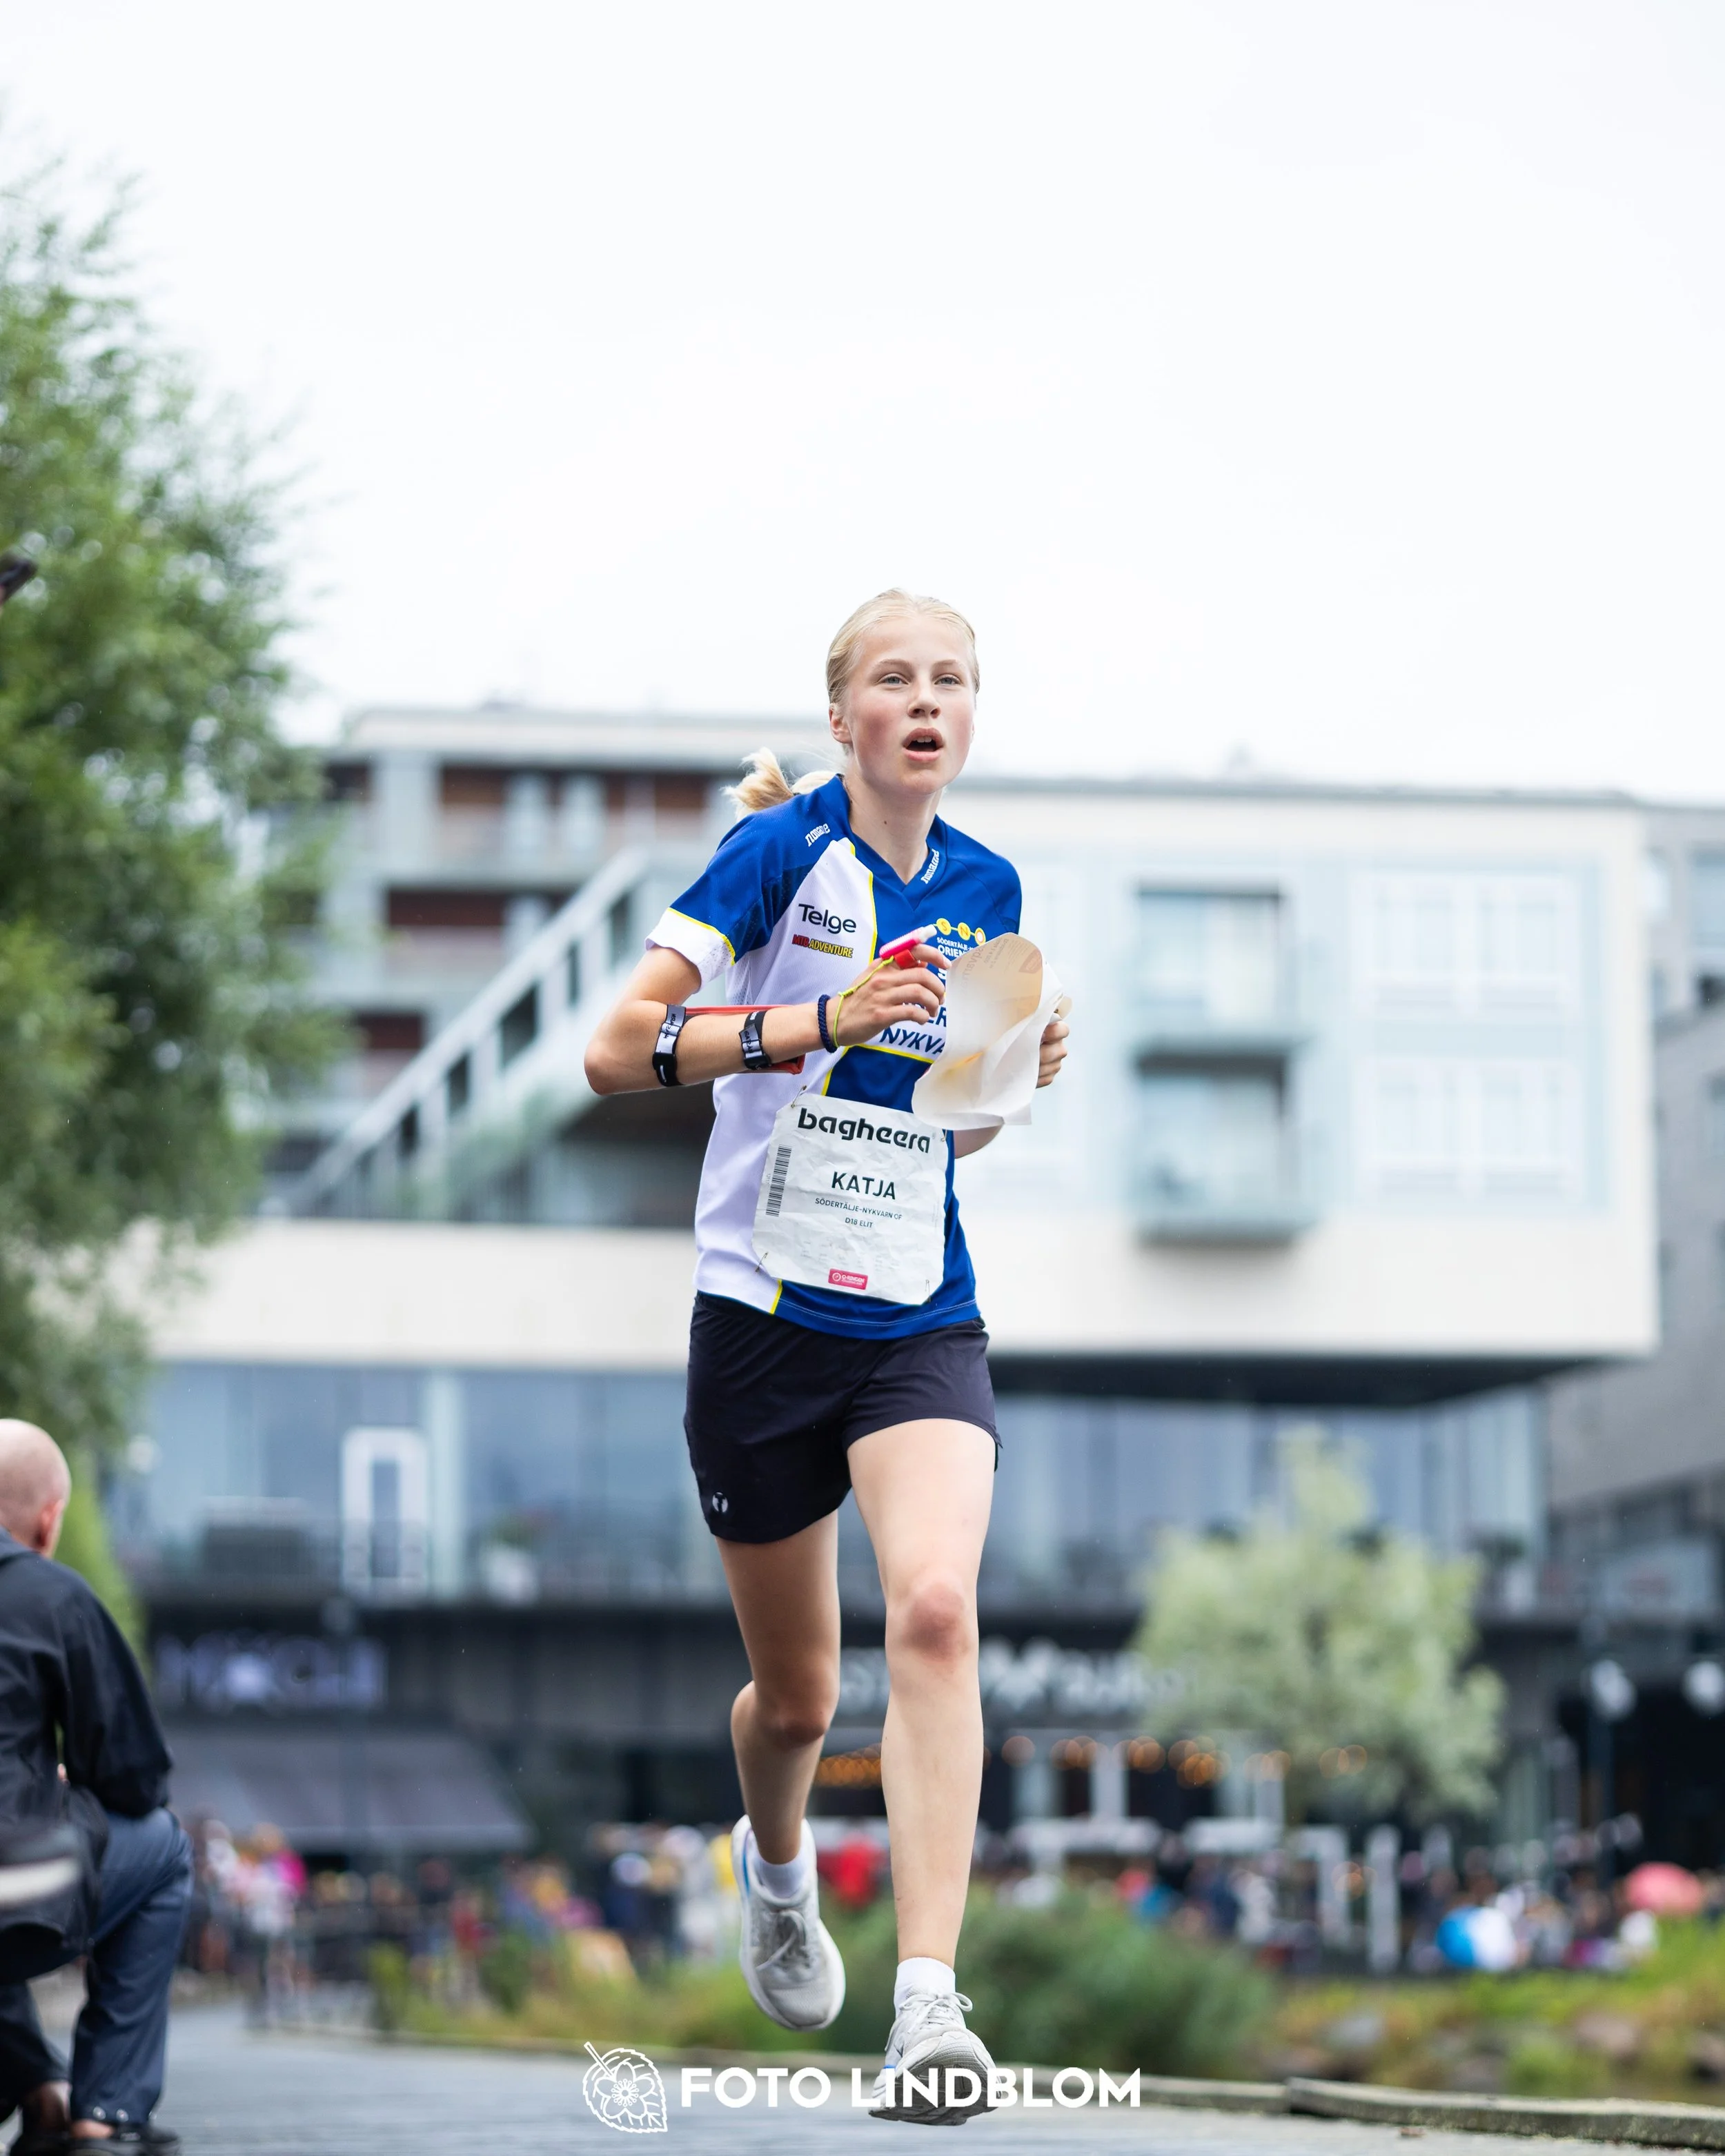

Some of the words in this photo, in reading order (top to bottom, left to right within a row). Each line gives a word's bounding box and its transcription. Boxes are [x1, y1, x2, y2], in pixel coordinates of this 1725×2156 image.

[798, 903, 856, 934] Telge
[808, 938, 854, 958] ADVENTURE
[938, 945, 967, 958] ORIEN
[798, 1107, 930, 1153] bagheera
[831, 1171, 896, 1200] KATJA
[815, 1198, 893, 1219] SÖDERTÄLJE-NYKVARN
[845, 1217, 858, 1225] D18
[860, 1220, 874, 1228] ELIT
